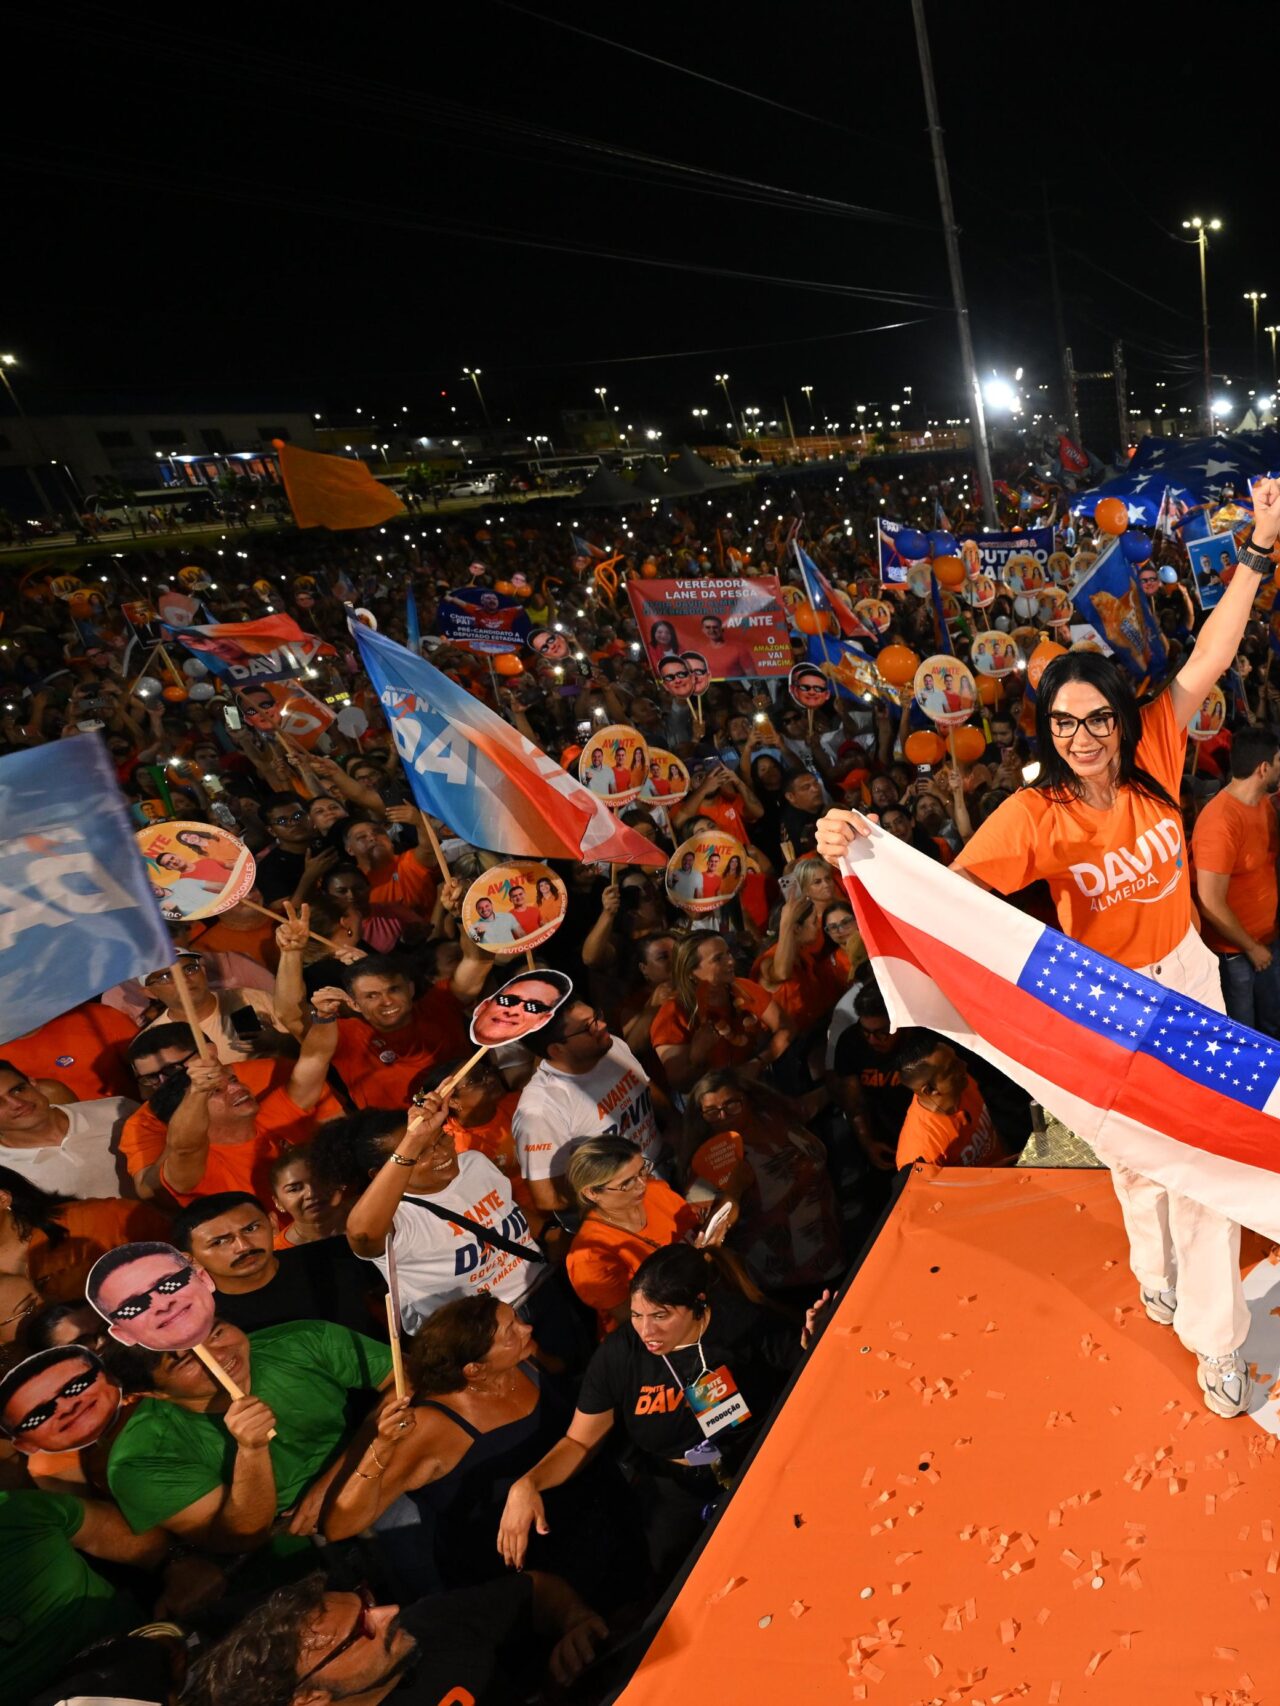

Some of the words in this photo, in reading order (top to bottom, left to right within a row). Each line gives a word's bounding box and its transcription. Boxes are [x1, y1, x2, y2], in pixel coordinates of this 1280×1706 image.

[665, 590, 697, 600] LANE
[701, 590, 717, 599] DA
[720, 588, 758, 598] PESCA
[676, 579, 749, 589] VEREADORA
[758, 659, 793, 667] #PRACIM
[1068, 818, 1181, 897] DAVID
[1090, 872, 1160, 912] ALMEIDA
[597, 1069, 640, 1120] AVANTE
[705, 1402, 741, 1428] PRODUÇÃO
